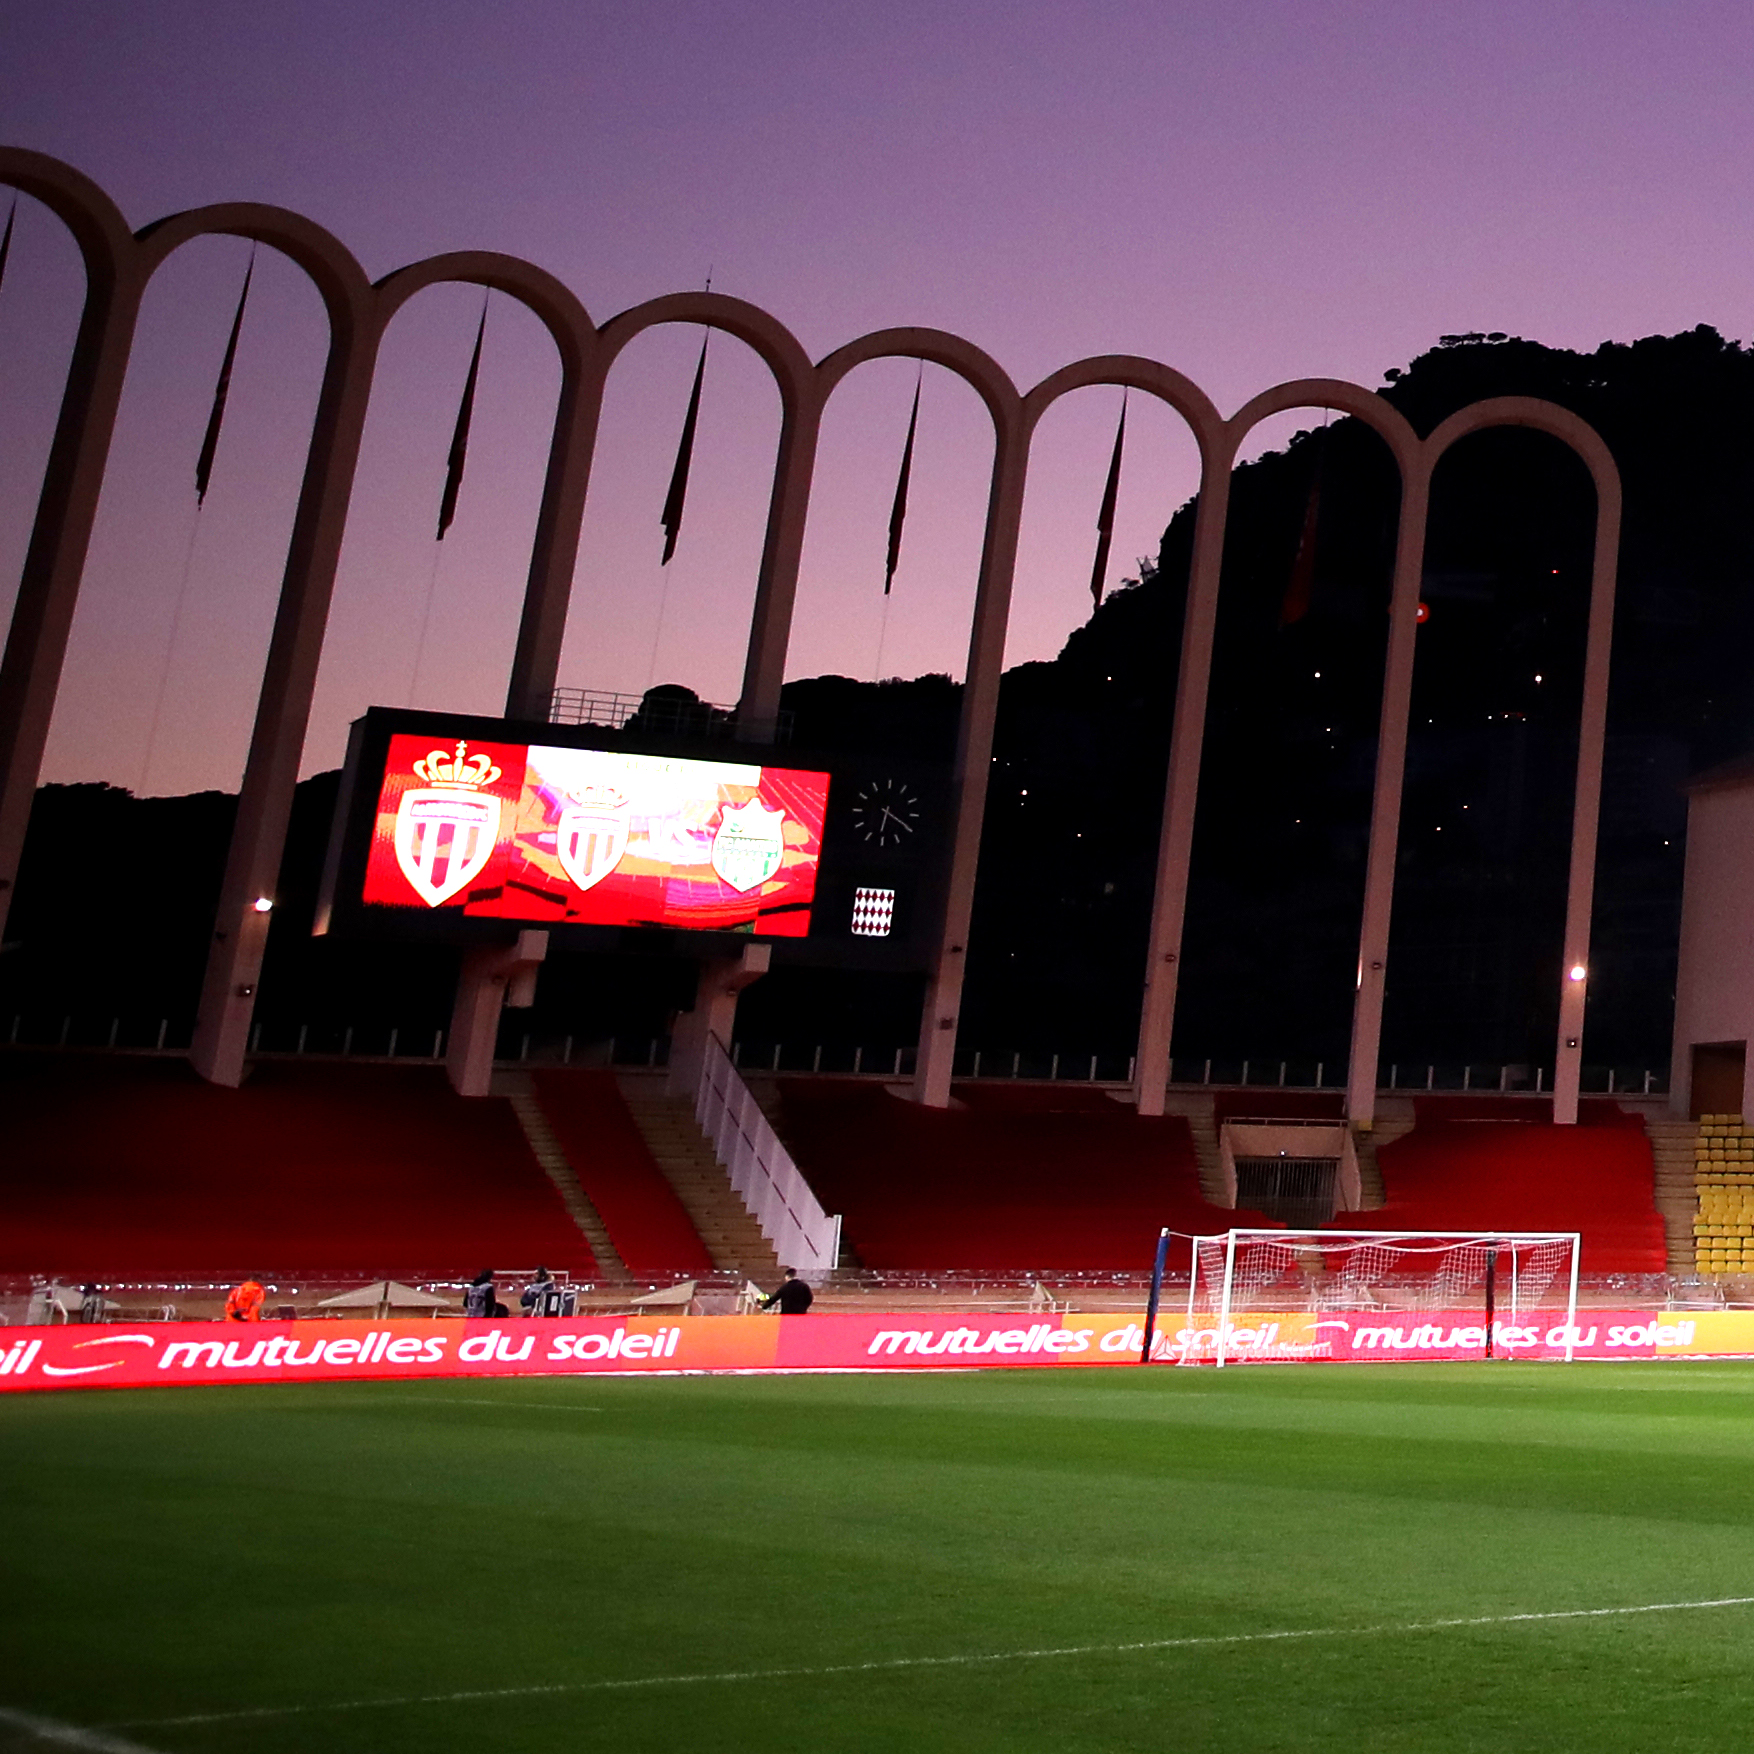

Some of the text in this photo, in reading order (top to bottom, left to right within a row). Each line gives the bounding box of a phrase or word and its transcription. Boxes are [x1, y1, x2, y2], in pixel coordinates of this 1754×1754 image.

[157, 1327, 681, 1369] mutuelles du soleil
[867, 1324, 1094, 1355] mutuelles
[1171, 1322, 1280, 1352] soleil
[1545, 1321, 1598, 1347] du
[1605, 1320, 1697, 1347] soleil
[0, 1340, 42, 1374] il
